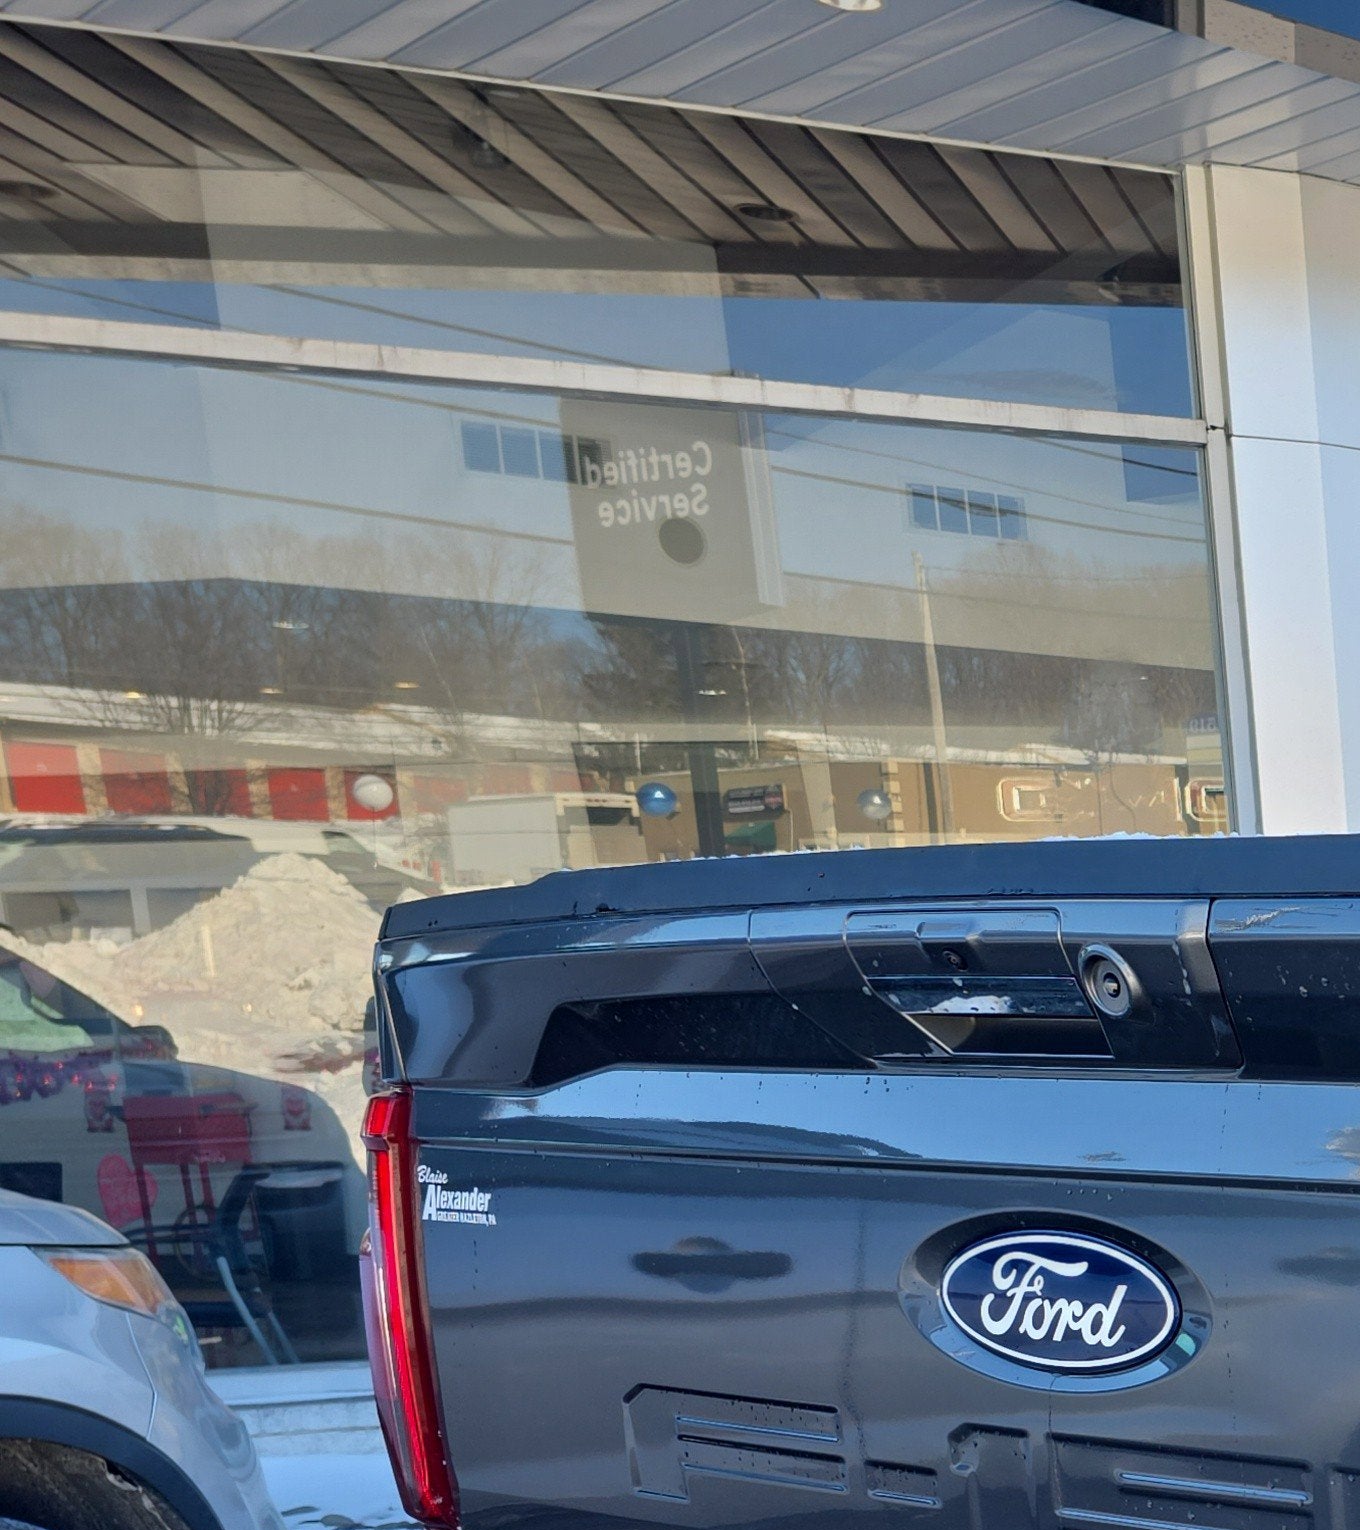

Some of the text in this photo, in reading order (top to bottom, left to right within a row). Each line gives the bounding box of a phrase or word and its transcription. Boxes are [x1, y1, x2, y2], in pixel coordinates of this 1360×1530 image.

[417, 1164, 449, 1184] Blaise
[422, 1184, 492, 1221] Alexander
[980, 1251, 1128, 1348] Ford
